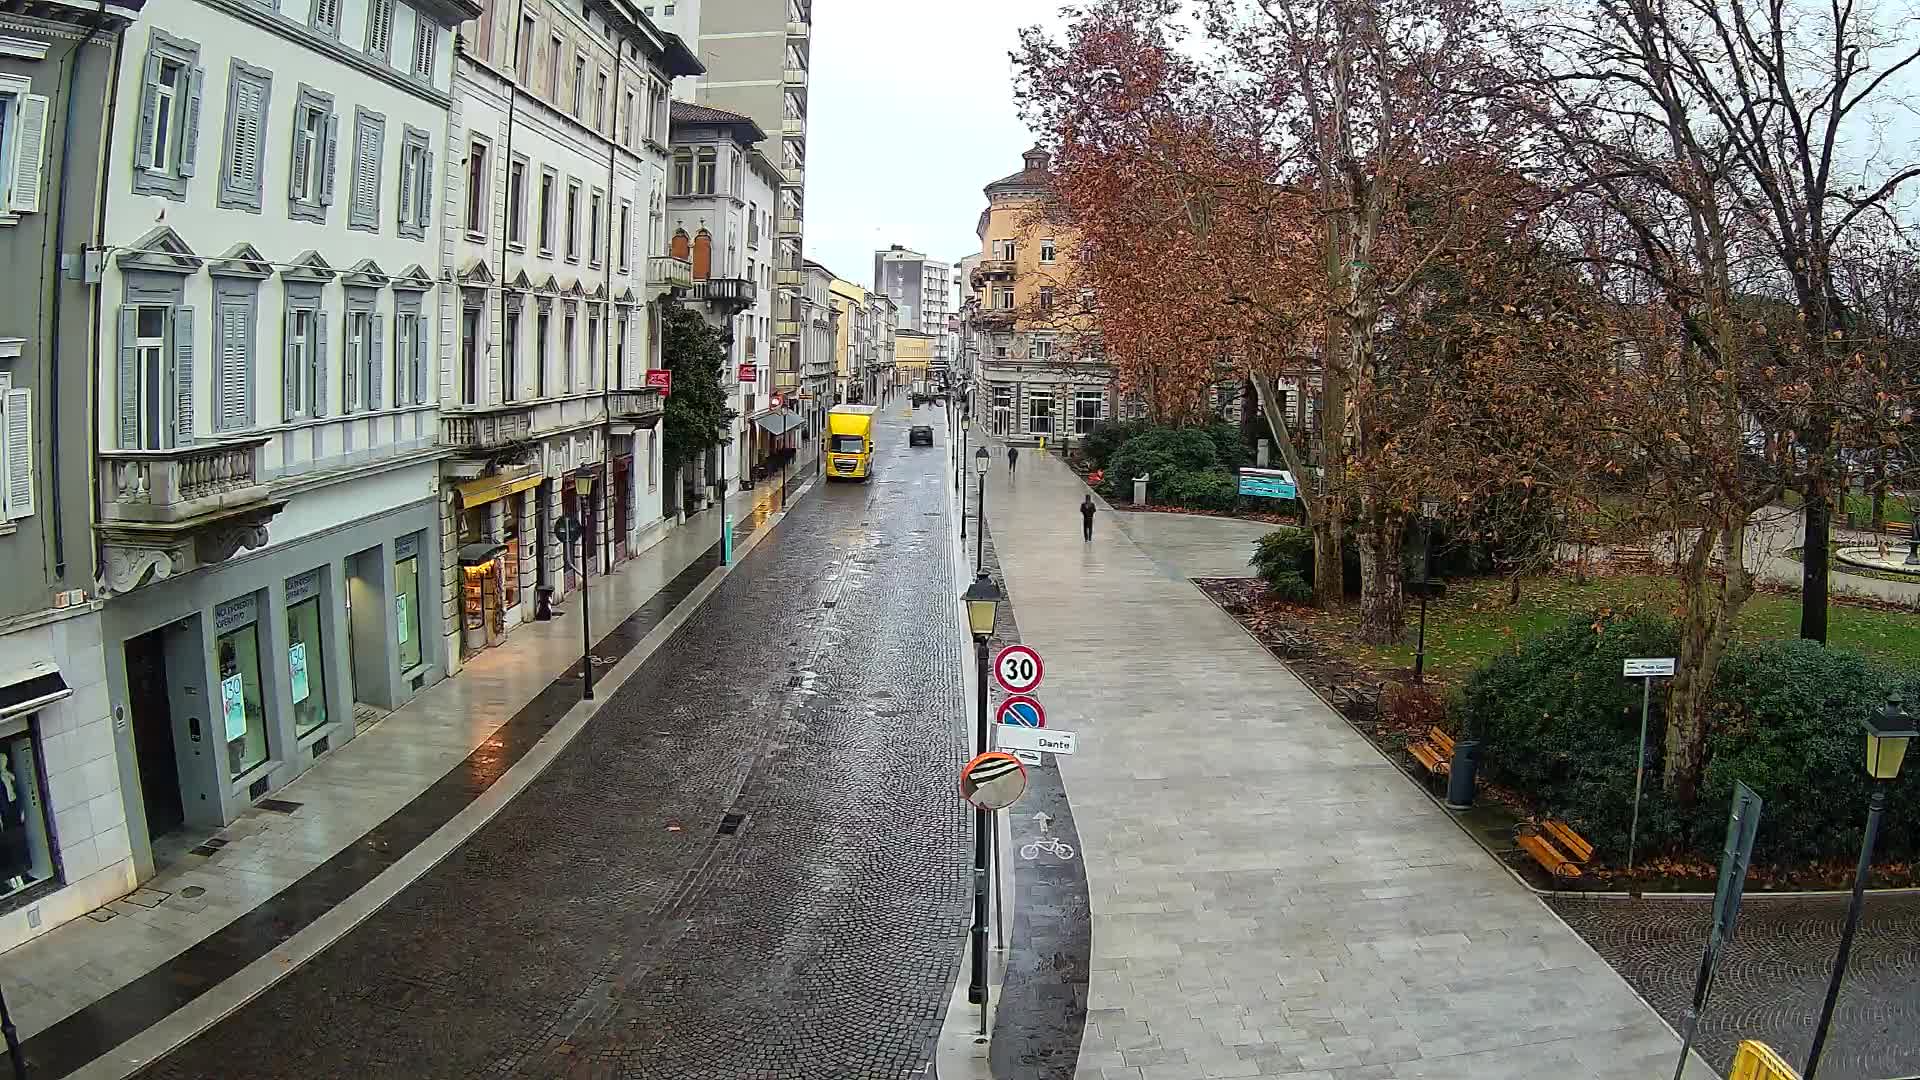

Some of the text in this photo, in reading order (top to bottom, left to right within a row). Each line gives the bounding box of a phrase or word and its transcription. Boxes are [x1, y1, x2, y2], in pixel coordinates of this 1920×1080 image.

[1006, 659, 1033, 680] 30
[223, 678, 241, 700] 130
[1039, 738, 1070, 749] Dante
